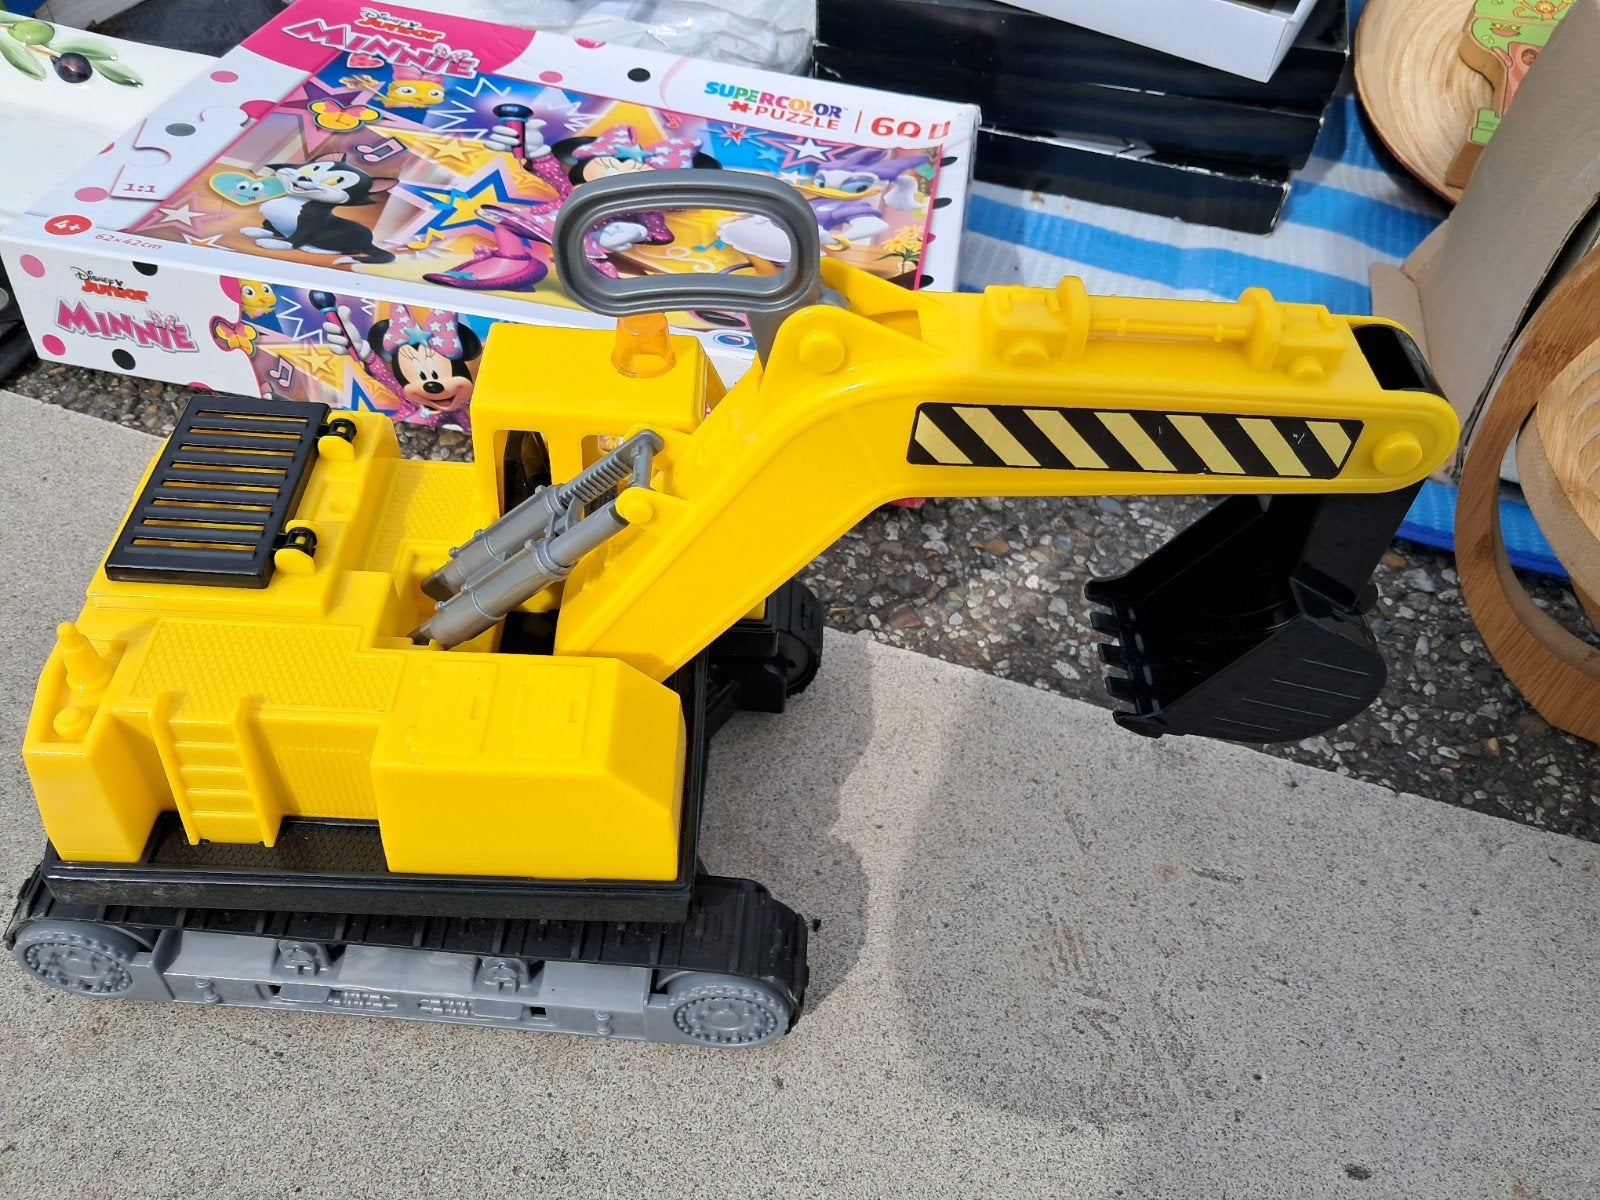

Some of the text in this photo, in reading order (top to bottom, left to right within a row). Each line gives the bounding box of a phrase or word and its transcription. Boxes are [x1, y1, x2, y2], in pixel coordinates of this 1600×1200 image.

[283, 19, 480, 78] MINNIE
[704, 81, 842, 119] SUPERCOLOR
[754, 105, 840, 131] PUZZLE
[871, 116, 922, 139] 60
[122, 183, 157, 194] 1:1
[53, 219, 81, 231] 4+
[70, 266, 117, 287] Disney
[81, 280, 149, 302] JUNIOR
[57, 298, 197, 351] MINNIE
